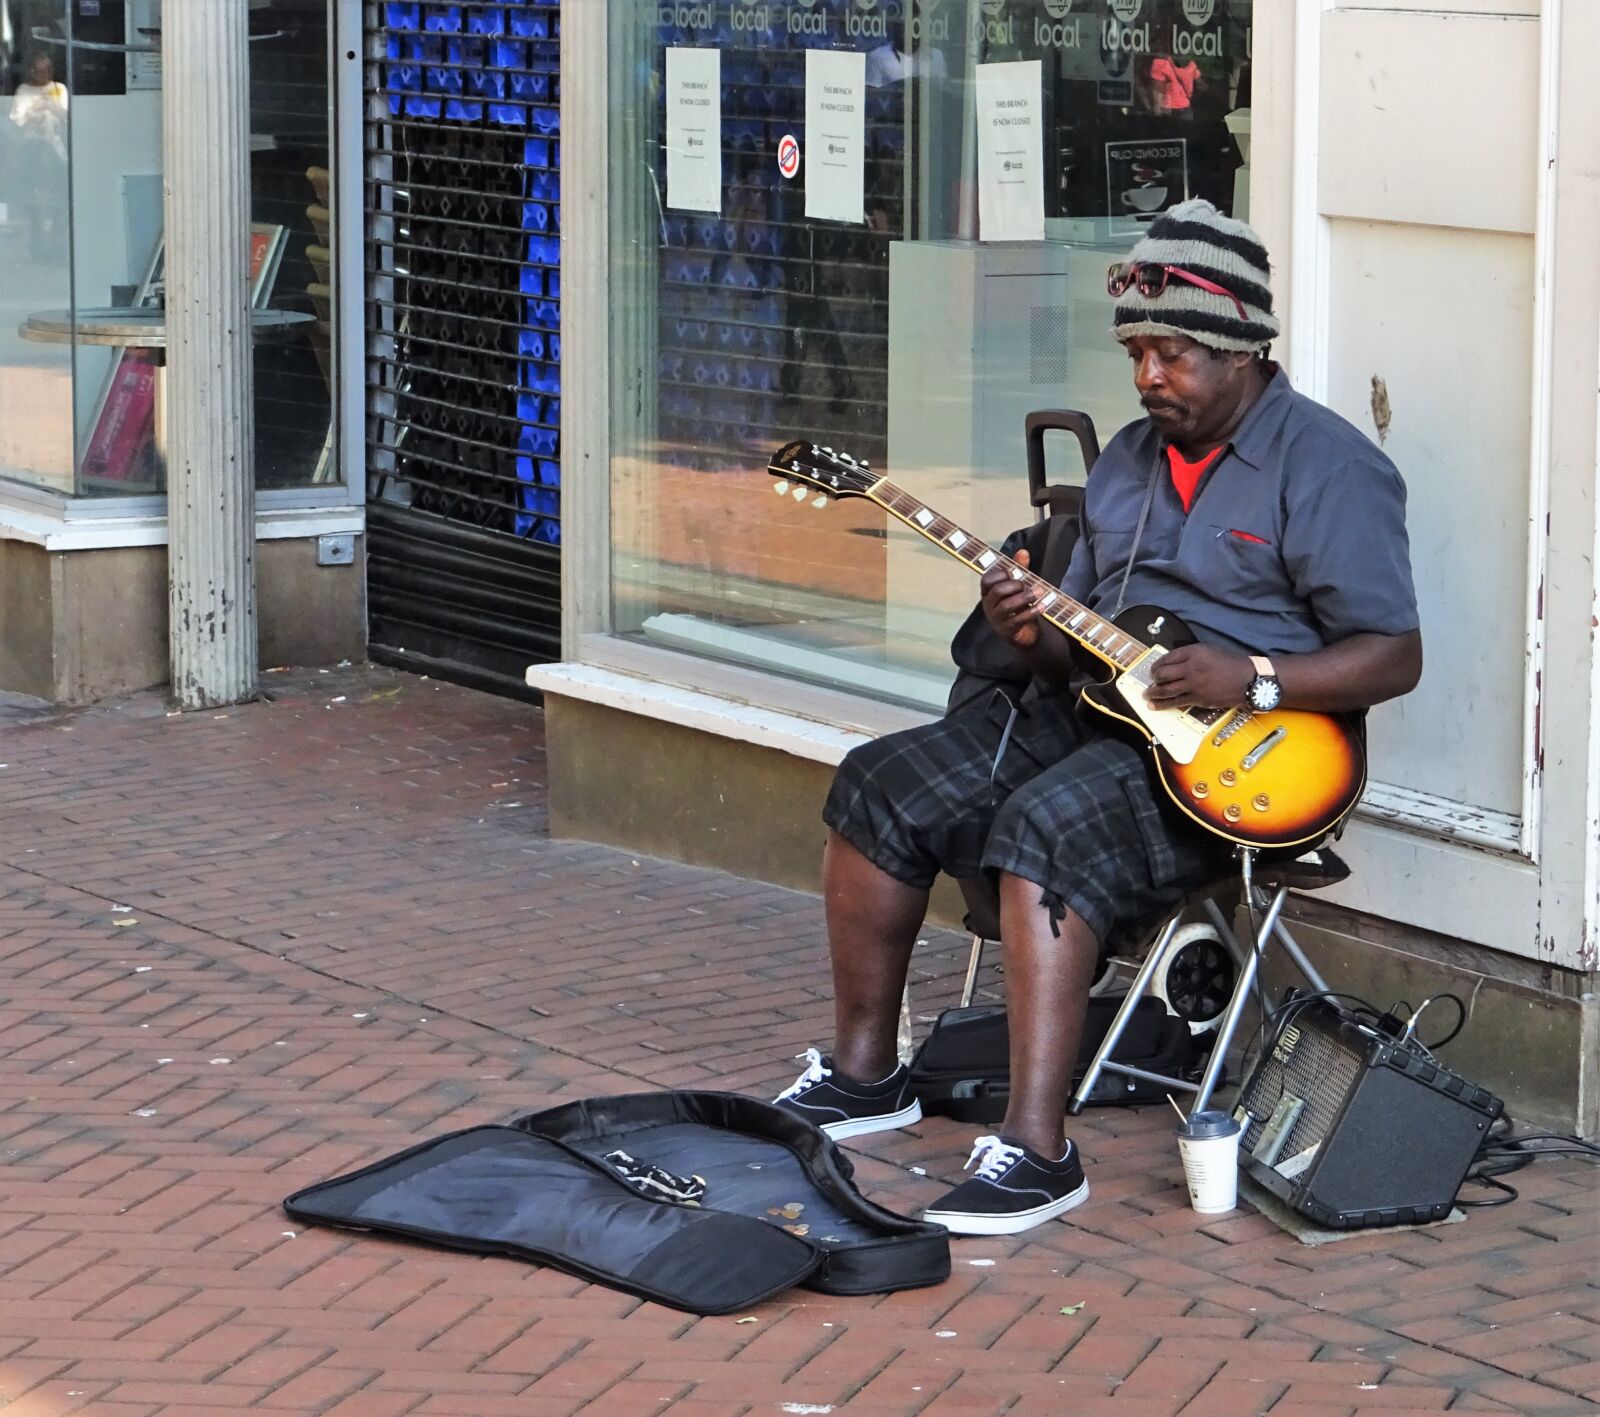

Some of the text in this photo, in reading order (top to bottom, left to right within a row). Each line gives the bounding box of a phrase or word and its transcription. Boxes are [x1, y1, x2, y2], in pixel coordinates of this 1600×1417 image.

[675, 4, 712, 30] local
[730, 6, 769, 33] local
[787, 6, 827, 35] local
[845, 8, 887, 38] local
[908, 12, 949, 41] oal
[1034, 16, 1081, 49] local
[1102, 19, 1150, 53] local
[1172, 23, 1223, 57] local
[833, 87, 853, 96] BRANCH
[824, 103, 835, 111] NOW
[836, 104, 855, 112] CLOSED
[995, 99, 1028, 108] THIS BRANCH
[999, 118, 1011, 126] NOW
[1011, 117, 1031, 125] CLOSED
